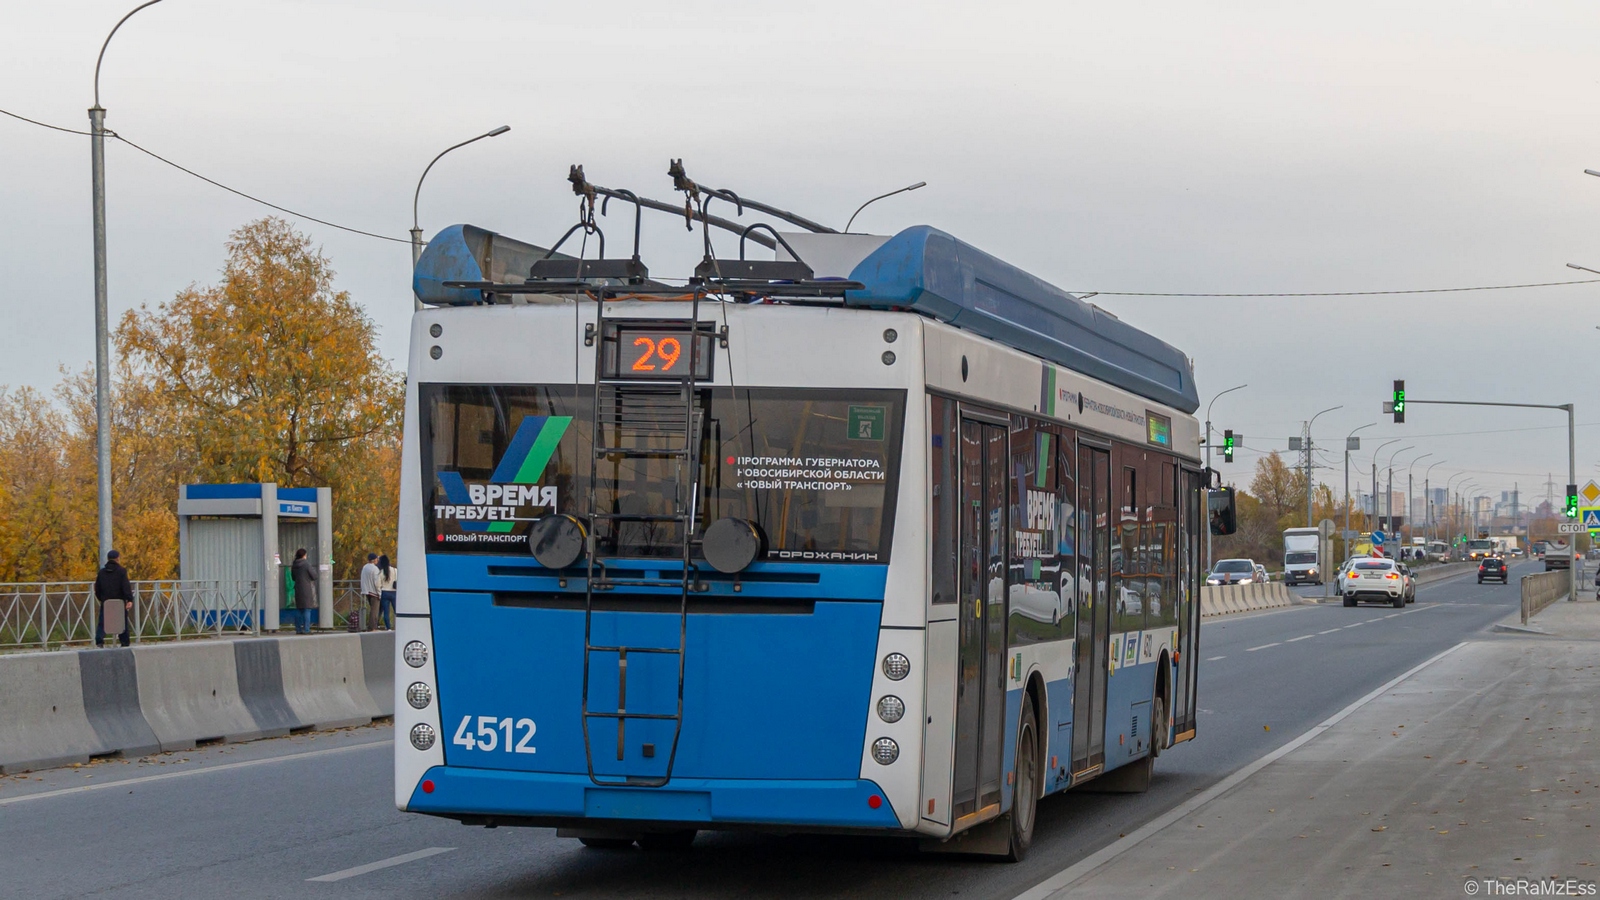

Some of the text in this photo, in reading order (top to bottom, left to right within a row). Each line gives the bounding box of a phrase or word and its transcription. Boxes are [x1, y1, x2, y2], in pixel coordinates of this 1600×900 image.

[632, 337, 681, 371] 29
[1393, 391, 1405, 401] 12
[1223, 437, 1234, 447] 12
[737, 457, 880, 467] ПРОГРАММА ГУБЕРНАТОРА
[737, 468, 885, 480] НОВОСИБИРСКОЙ ОБЛАСТИ
[784, 481, 852, 491] ТРАНСПОРТ»
[469, 484, 557, 507] ВРЕМЯ
[1566, 495, 1578, 506] 12
[434, 505, 516, 520] ТРЕБУЕТ!
[1027, 490, 1055, 530] ВРЕМЯ
[1560, 524, 1586, 532] СТОП
[445, 533, 528, 543] НОВЫЙ ТРАНСПОРТ
[767, 551, 878, 560] ГОРОЖАНИН
[453, 715, 537, 754] 4512
